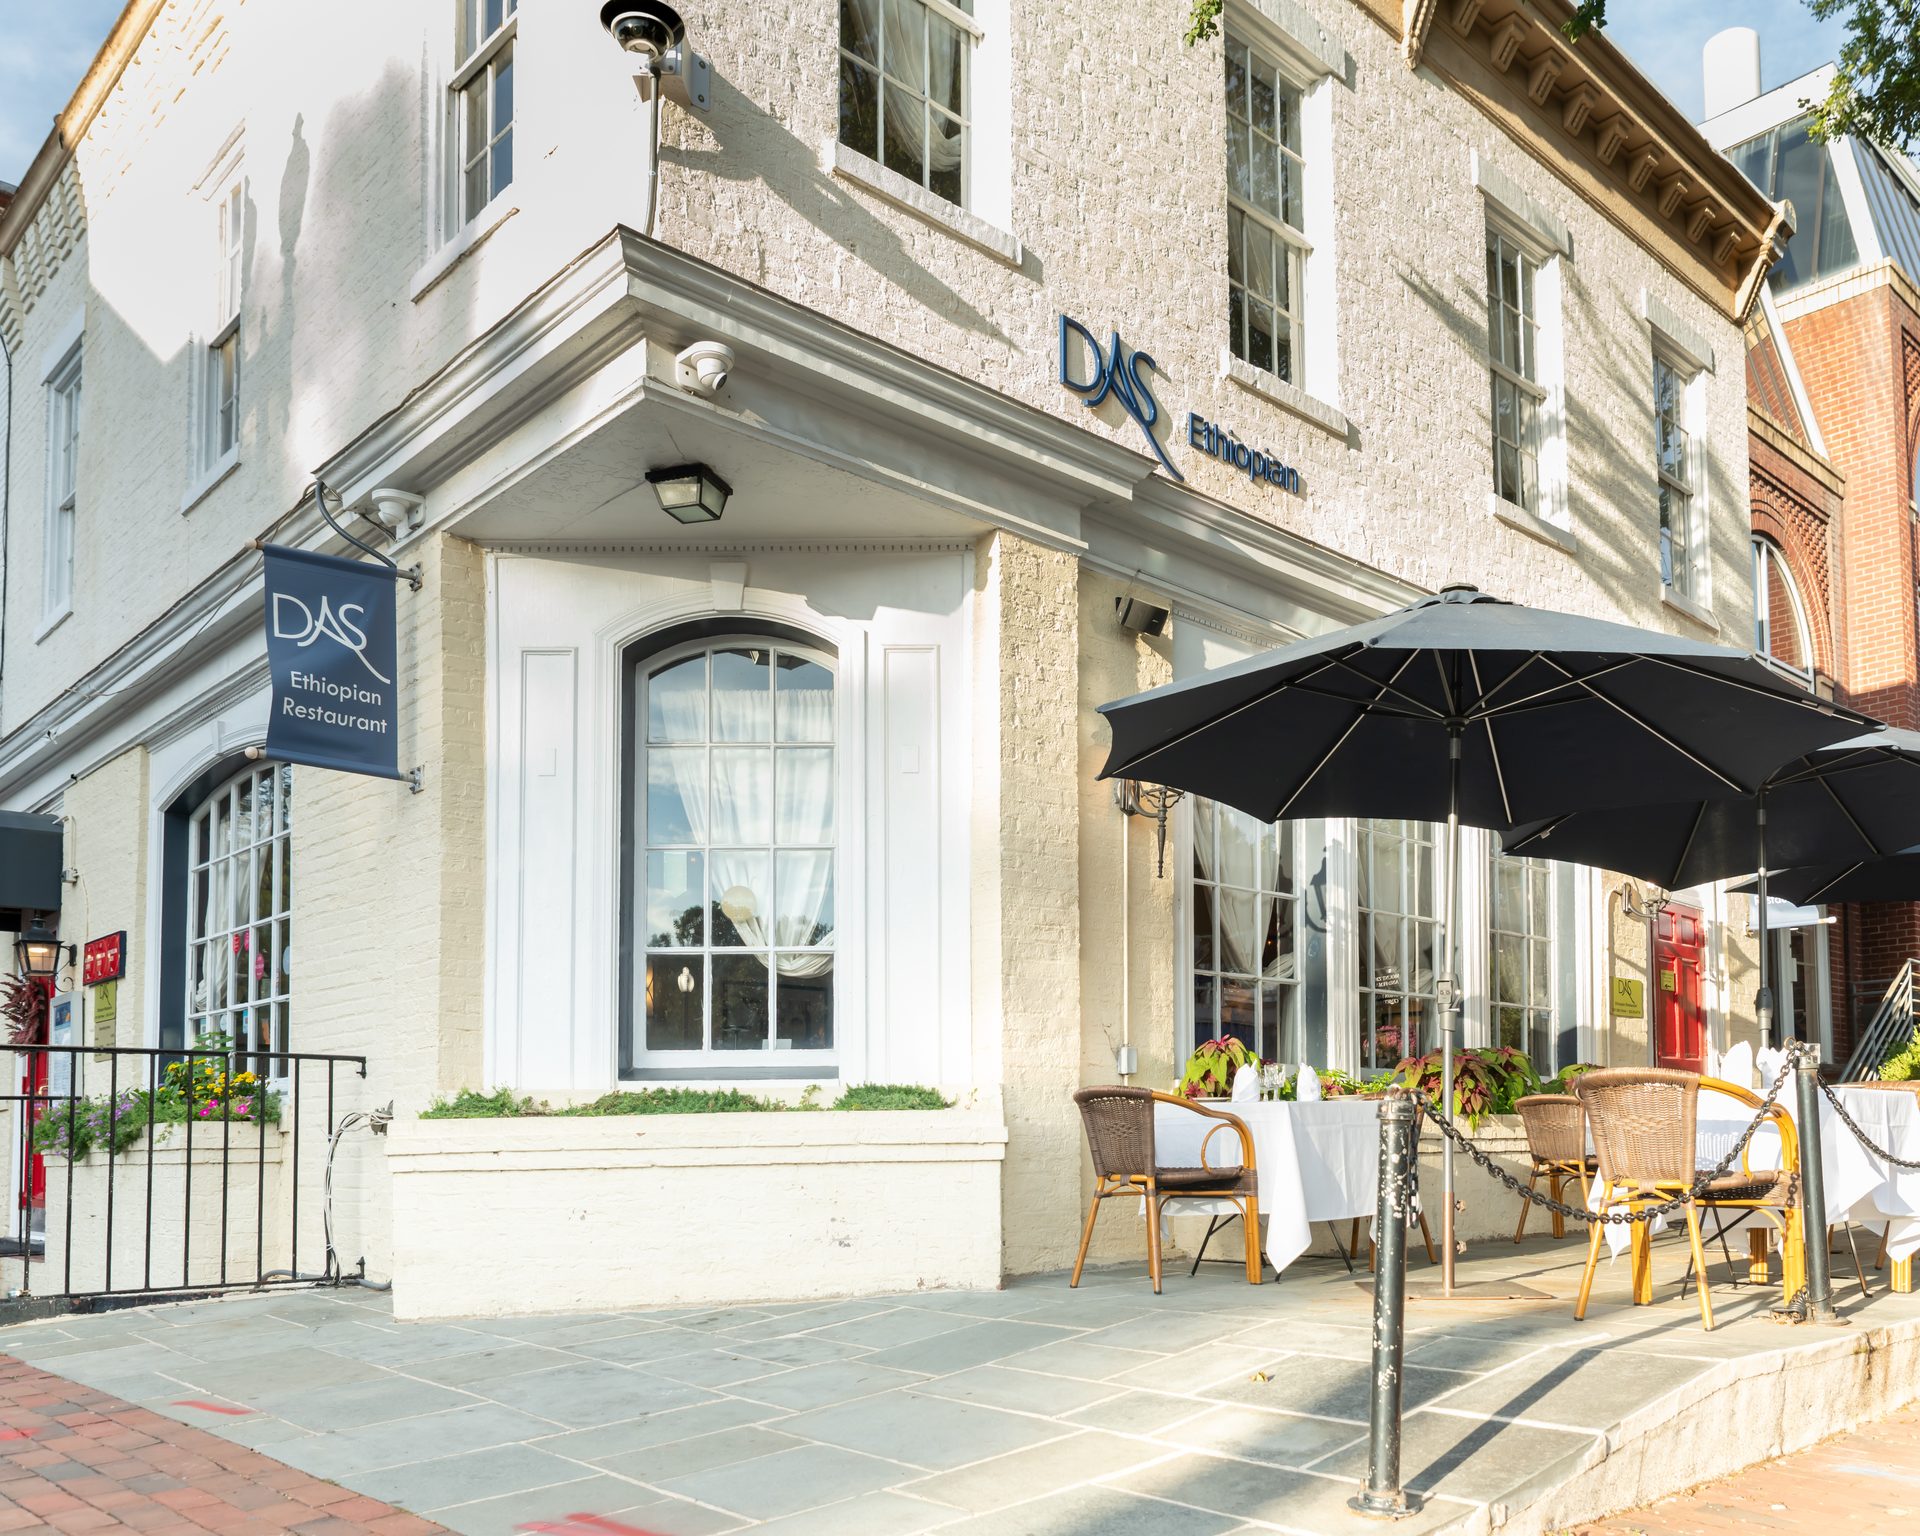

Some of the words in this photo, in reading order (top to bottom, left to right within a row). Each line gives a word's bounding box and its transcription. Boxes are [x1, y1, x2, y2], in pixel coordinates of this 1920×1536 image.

[1060, 314, 1184, 481] DAS
[1189, 411, 1300, 494] Ethiopian
[272, 592, 391, 685] DAS
[282, 696, 388, 734] Restaurant
[290, 670, 382, 706] Ethiopian
